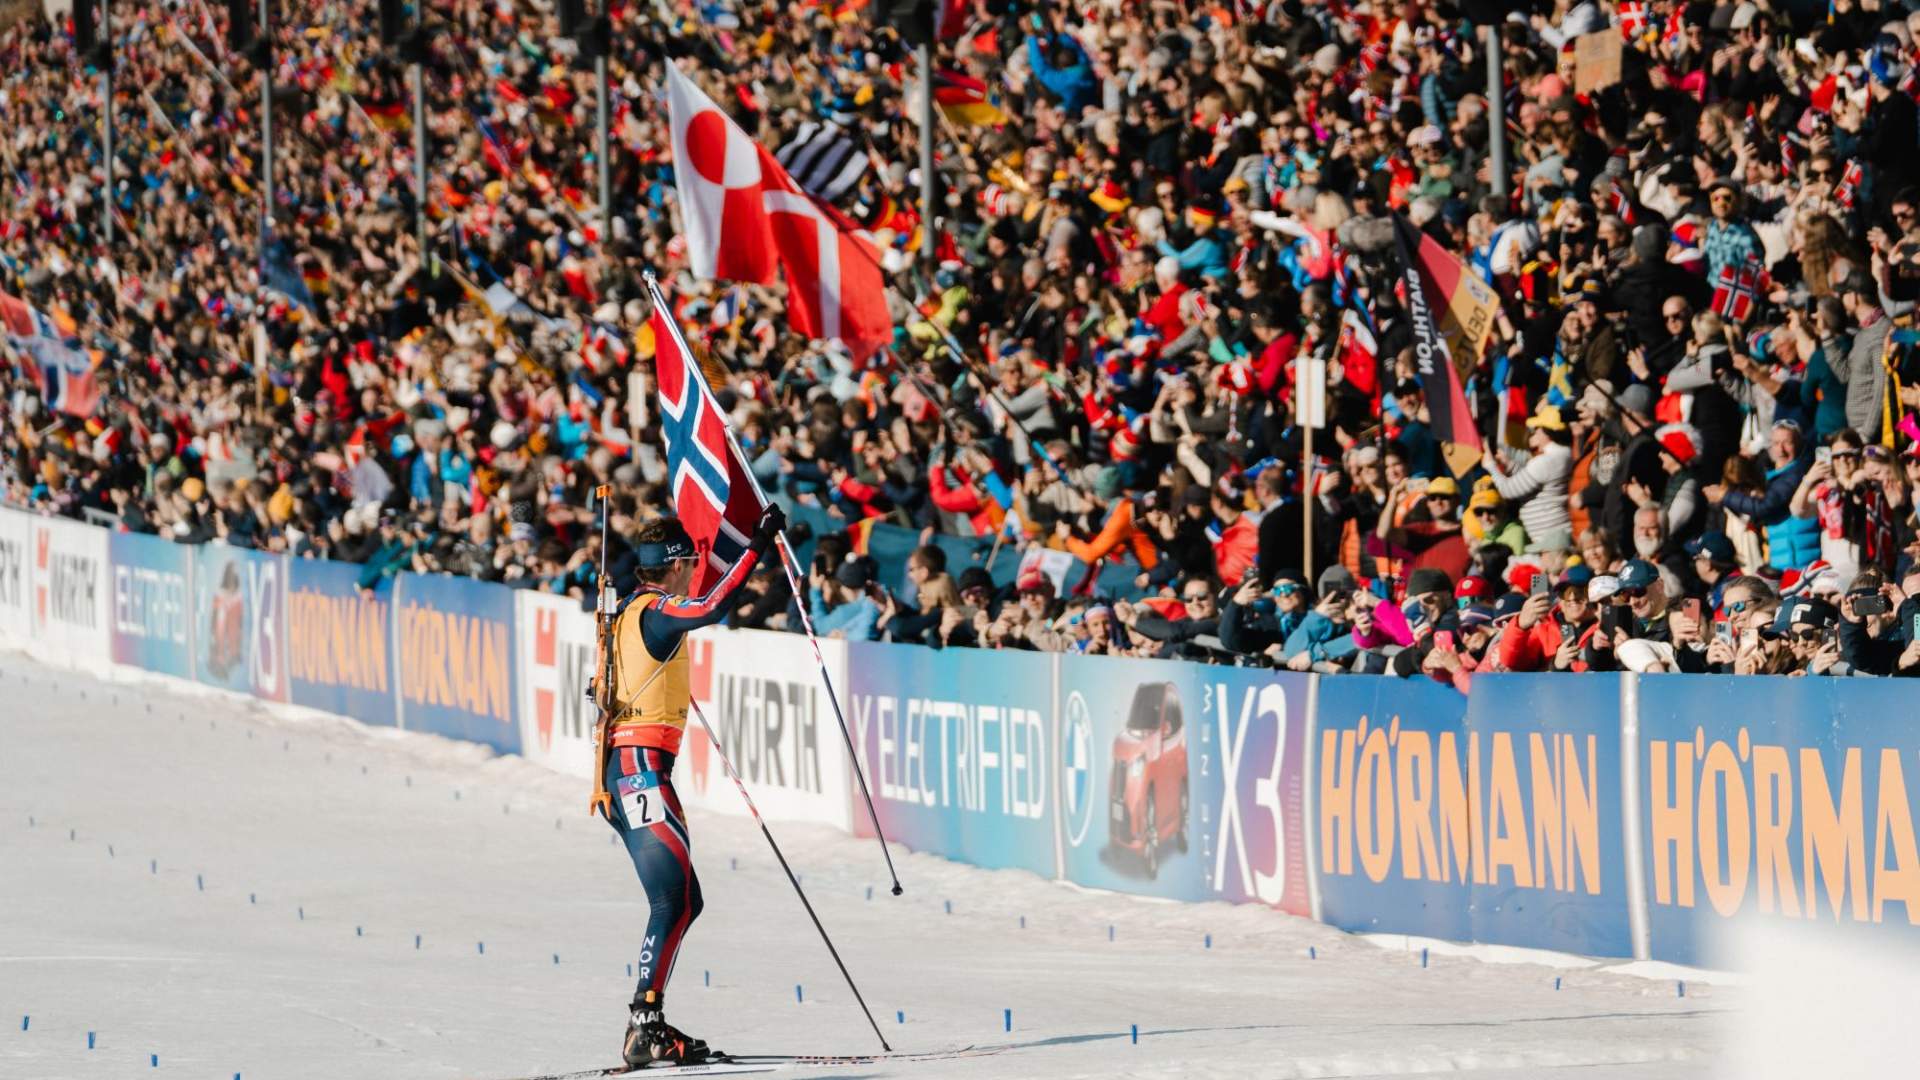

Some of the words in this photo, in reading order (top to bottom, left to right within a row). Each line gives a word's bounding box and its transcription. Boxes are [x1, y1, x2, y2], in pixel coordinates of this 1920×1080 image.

[247, 560, 276, 694] X3
[719, 672, 823, 794] WÜRTH
[1214, 683, 1287, 904] X3
[637, 794, 652, 824] 2
[1320, 715, 1600, 894] HÖRMANN
[640, 935, 656, 979] NOR
